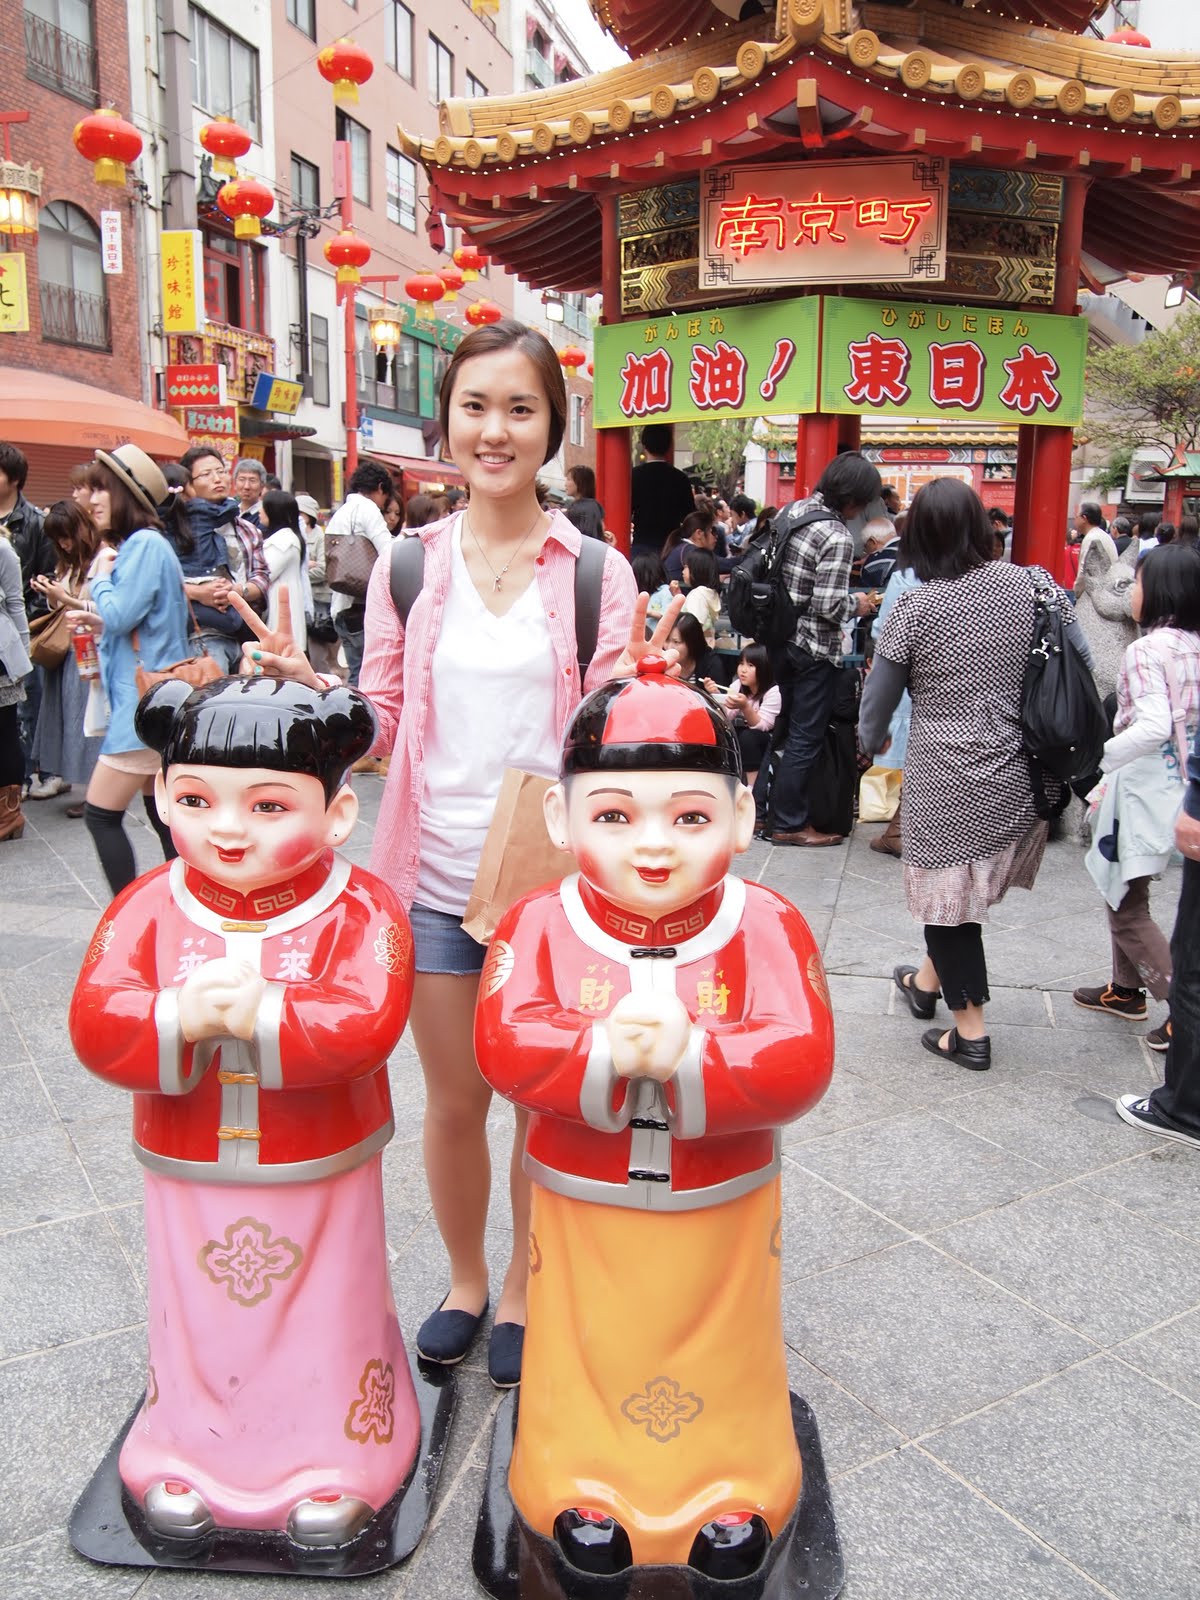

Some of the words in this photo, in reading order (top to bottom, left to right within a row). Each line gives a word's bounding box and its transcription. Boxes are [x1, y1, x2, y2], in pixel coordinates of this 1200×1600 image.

[715, 192, 932, 256] 南京町
[166, 255, 182, 320] 珍味館
[644, 317, 725, 343] がんばれ
[881, 308, 1029, 338] ひがしにほん
[619, 338, 797, 418] 加油!
[843, 331, 1062, 416] 東日本
[182, 936, 207, 949] ライ
[281, 935, 308, 946] ライ
[275, 948, 313, 980] 來
[585, 963, 611, 975] ザイ
[701, 967, 725, 980] ザイ
[578, 977, 615, 1012] 財
[697, 981, 732, 1016] 財
